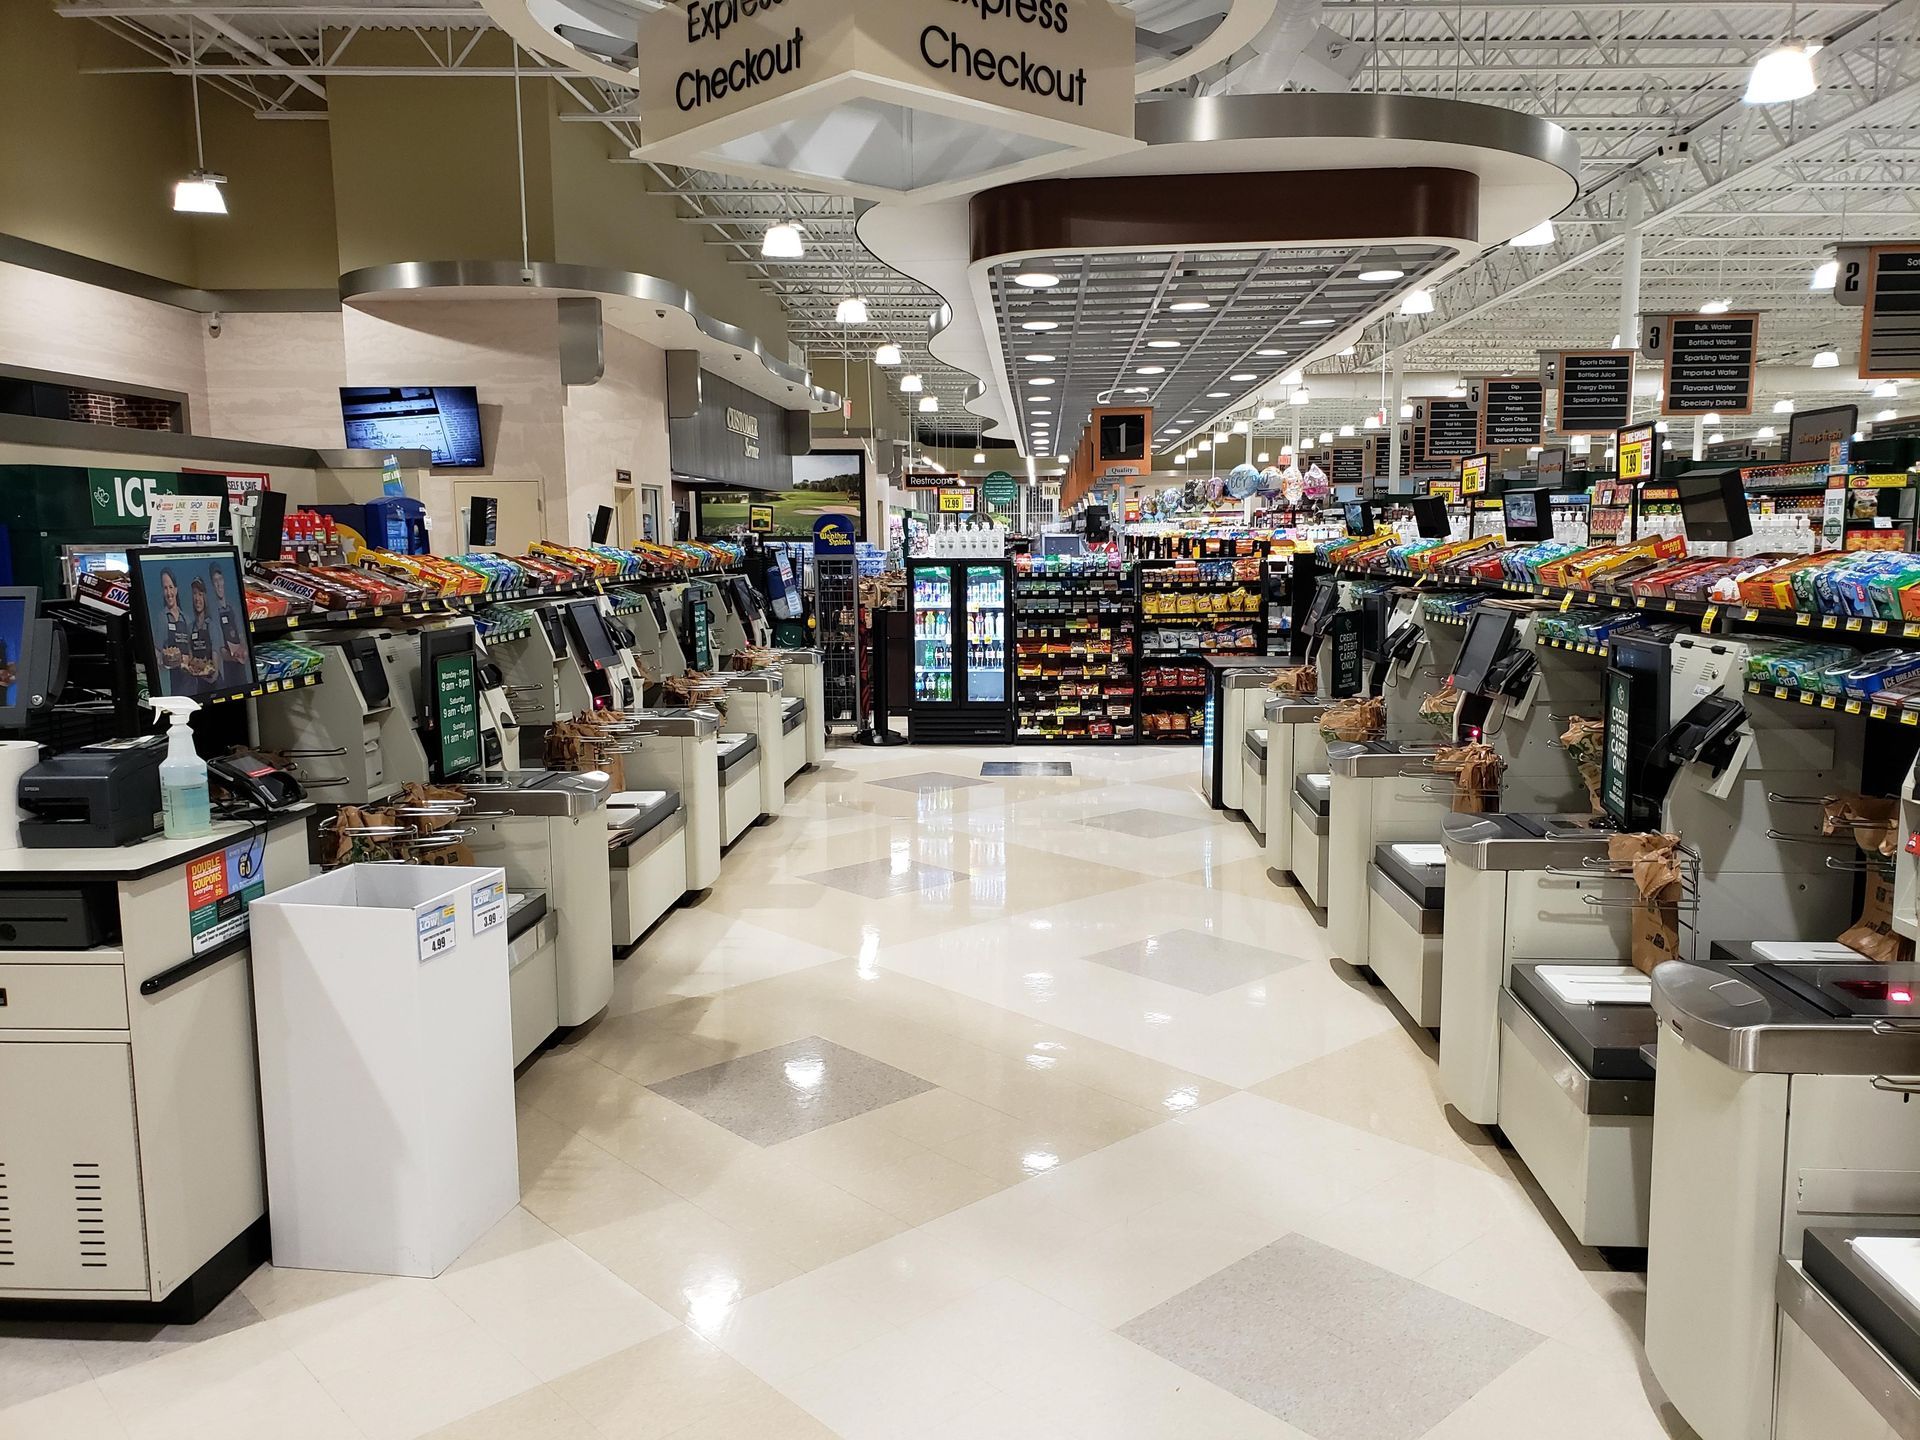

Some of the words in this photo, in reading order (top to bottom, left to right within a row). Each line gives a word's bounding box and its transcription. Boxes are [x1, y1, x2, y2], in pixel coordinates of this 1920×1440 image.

[687, 0, 785, 43] Expre
[676, 27, 804, 112] Checkout
[920, 25, 1086, 106] Checkout
[1844, 261, 1860, 292] 2
[1650, 326, 1660, 349] 3
[1472, 386, 1479, 402] 5
[1416, 405, 1422, 420] 6
[1119, 422, 1126, 453] 1
[1626, 454, 1636, 474] 7.99
[228, 480, 240, 490] SELF
[910, 476, 954, 485] Restrooms
[114, 477, 157, 517] ICE
[190, 501, 203, 509] SHOP
[944, 500, 960, 508] 12.99
[206, 501, 219, 510] EARN
[820, 532, 848, 540] Weather
[829, 538, 851, 547] Station
[272, 578, 314, 598] SNICKERS
[1340, 632, 1357, 642] CREDIT
[1344, 641, 1358, 651] DEBIT
[1340, 651, 1356, 661] CARDS
[1342, 660, 1354, 670] ONLY
[442, 672, 457, 680] Monday
[459, 668, 470, 677] Friday
[1883, 678, 1896, 689] ICE
[450, 696, 466, 705] Saturday
[452, 722, 466, 730] Sunday
[1612, 706, 1628, 730] CREDIT
[1616, 724, 1628, 744] DEBIT
[1611, 738, 1627, 760] CARDS
[1612, 755, 1624, 775] ONLY
[191, 856, 220, 876] DOUBLE
[192, 872, 222, 891] COUPONS
[194, 884, 214, 896] everyday
[484, 912, 496, 928] 3.99
[432, 936, 446, 952] 4.99
